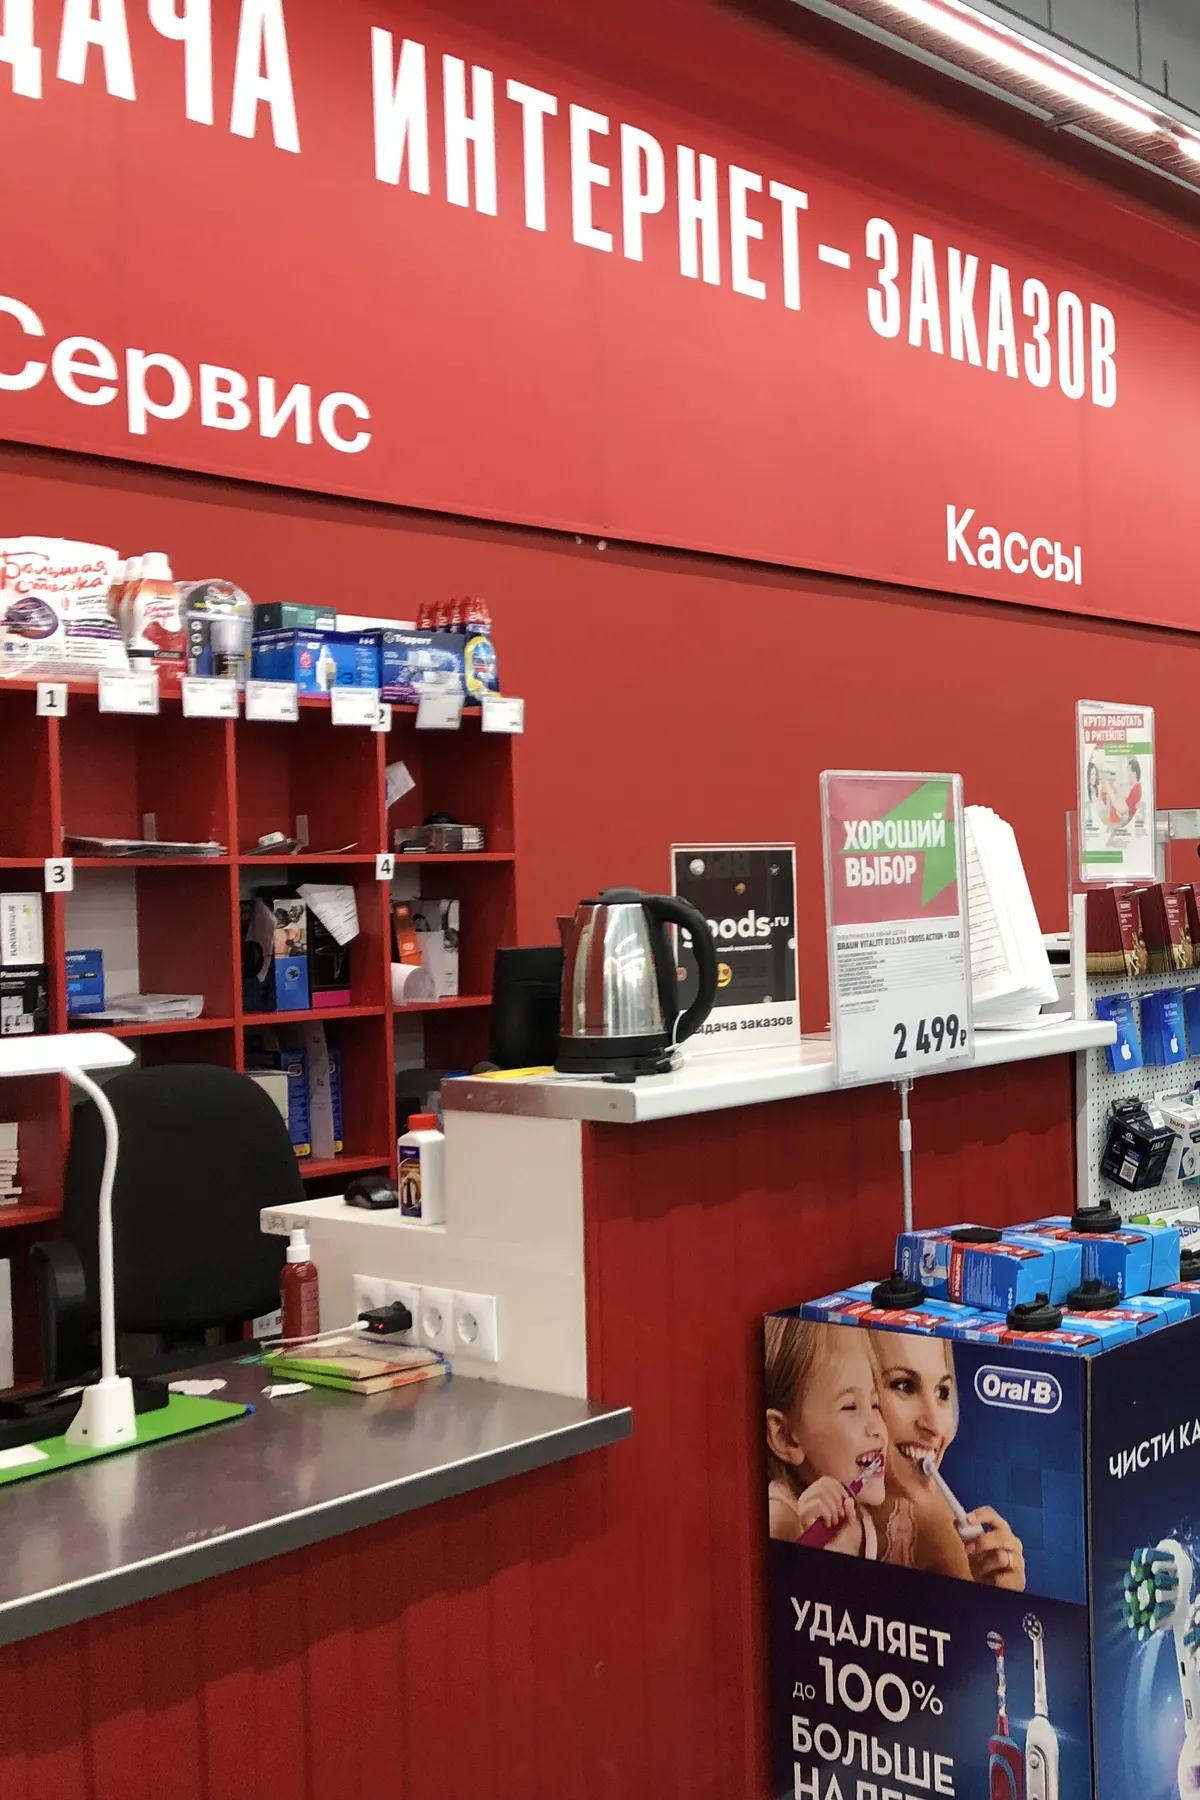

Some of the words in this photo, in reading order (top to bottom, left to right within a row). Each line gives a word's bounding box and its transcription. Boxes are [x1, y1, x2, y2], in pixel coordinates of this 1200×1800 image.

[0, 295, 372, 453] Сервис
[946, 504, 1082, 585] Кассы
[45, 690, 57, 708] 1
[1083, 715, 1107, 727] КРУТО
[1108, 715, 1143, 727] РАБОТАТЬ
[1085, 730, 1090, 741] В
[842, 812, 946, 850] ХОРОШИЙ
[52, 866, 65, 883] 3
[380, 859, 391, 876] 4
[845, 855, 917, 887] ВЫБОР
[837, 940, 859, 951] BRAUN
[860, 938, 884, 949] VITALITY
[908, 934, 925, 943] CROSS
[926, 932, 943, 941] ACTION
[694, 1020, 738, 1035] ыдача
[740, 1016, 793, 1031] заказов
[893, 1022, 908, 1060] 2
[1179, 1225, 1199, 1239] ASIO
[982, 1374, 1052, 1405] Oral-B
[1109, 1429, 1175, 1479] ЧИСТИ
[790, 1596, 951, 1667] УДАЛЯЕТ
[818, 1656, 944, 1723] 100%
[792, 1714, 956, 1797] БОЛЬШЕ
